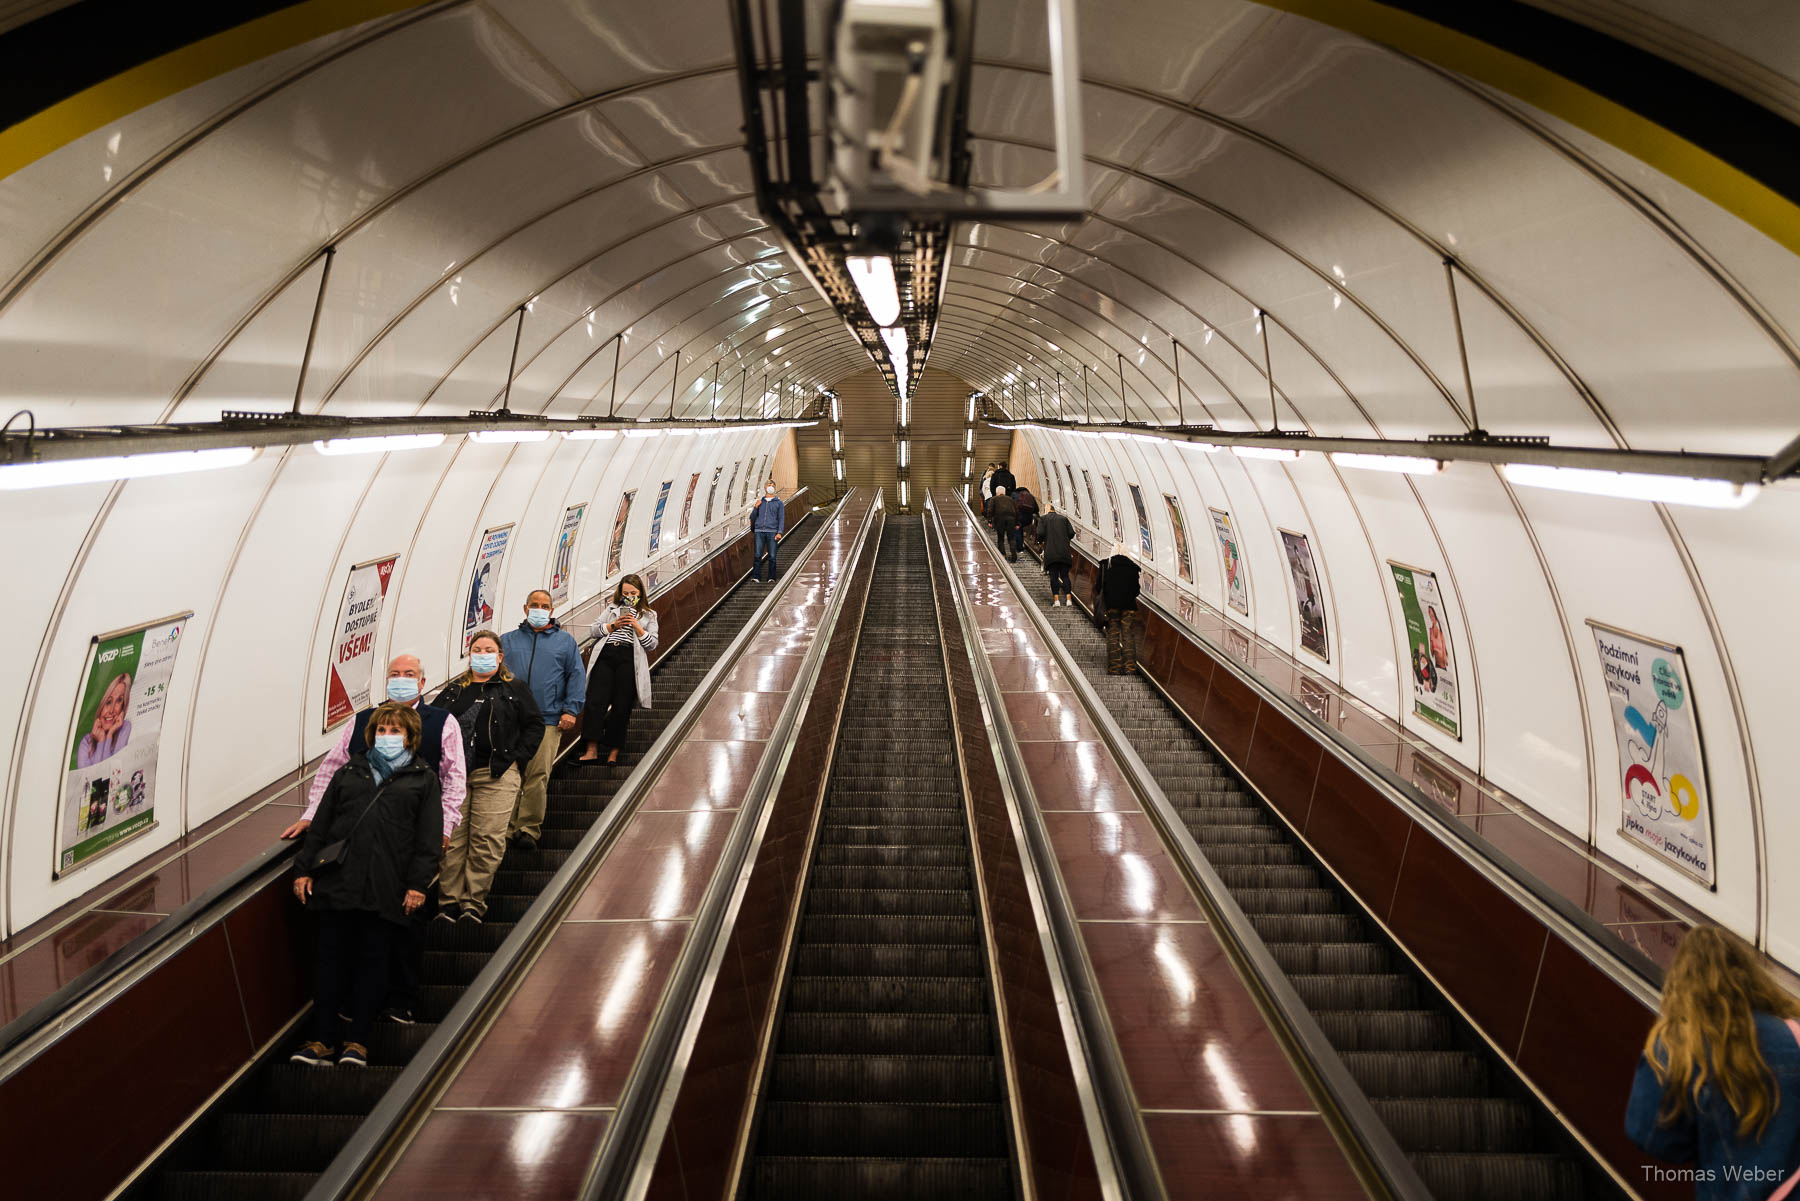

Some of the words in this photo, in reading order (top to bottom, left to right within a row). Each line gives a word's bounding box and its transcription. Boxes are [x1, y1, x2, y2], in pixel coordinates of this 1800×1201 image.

[344, 608, 378, 634] DOSTUPNÉ
[339, 631, 373, 664] VŠEM!
[1599, 639, 1639, 666] Podzimní
[1602, 657, 1641, 685] jazykové
[144, 685, 156, 697] -15
[158, 682, 165, 692] %
[1641, 790, 1657, 803] START
[1625, 816, 1644, 834] jipka
[1664, 837, 1706, 871] jazykovka
